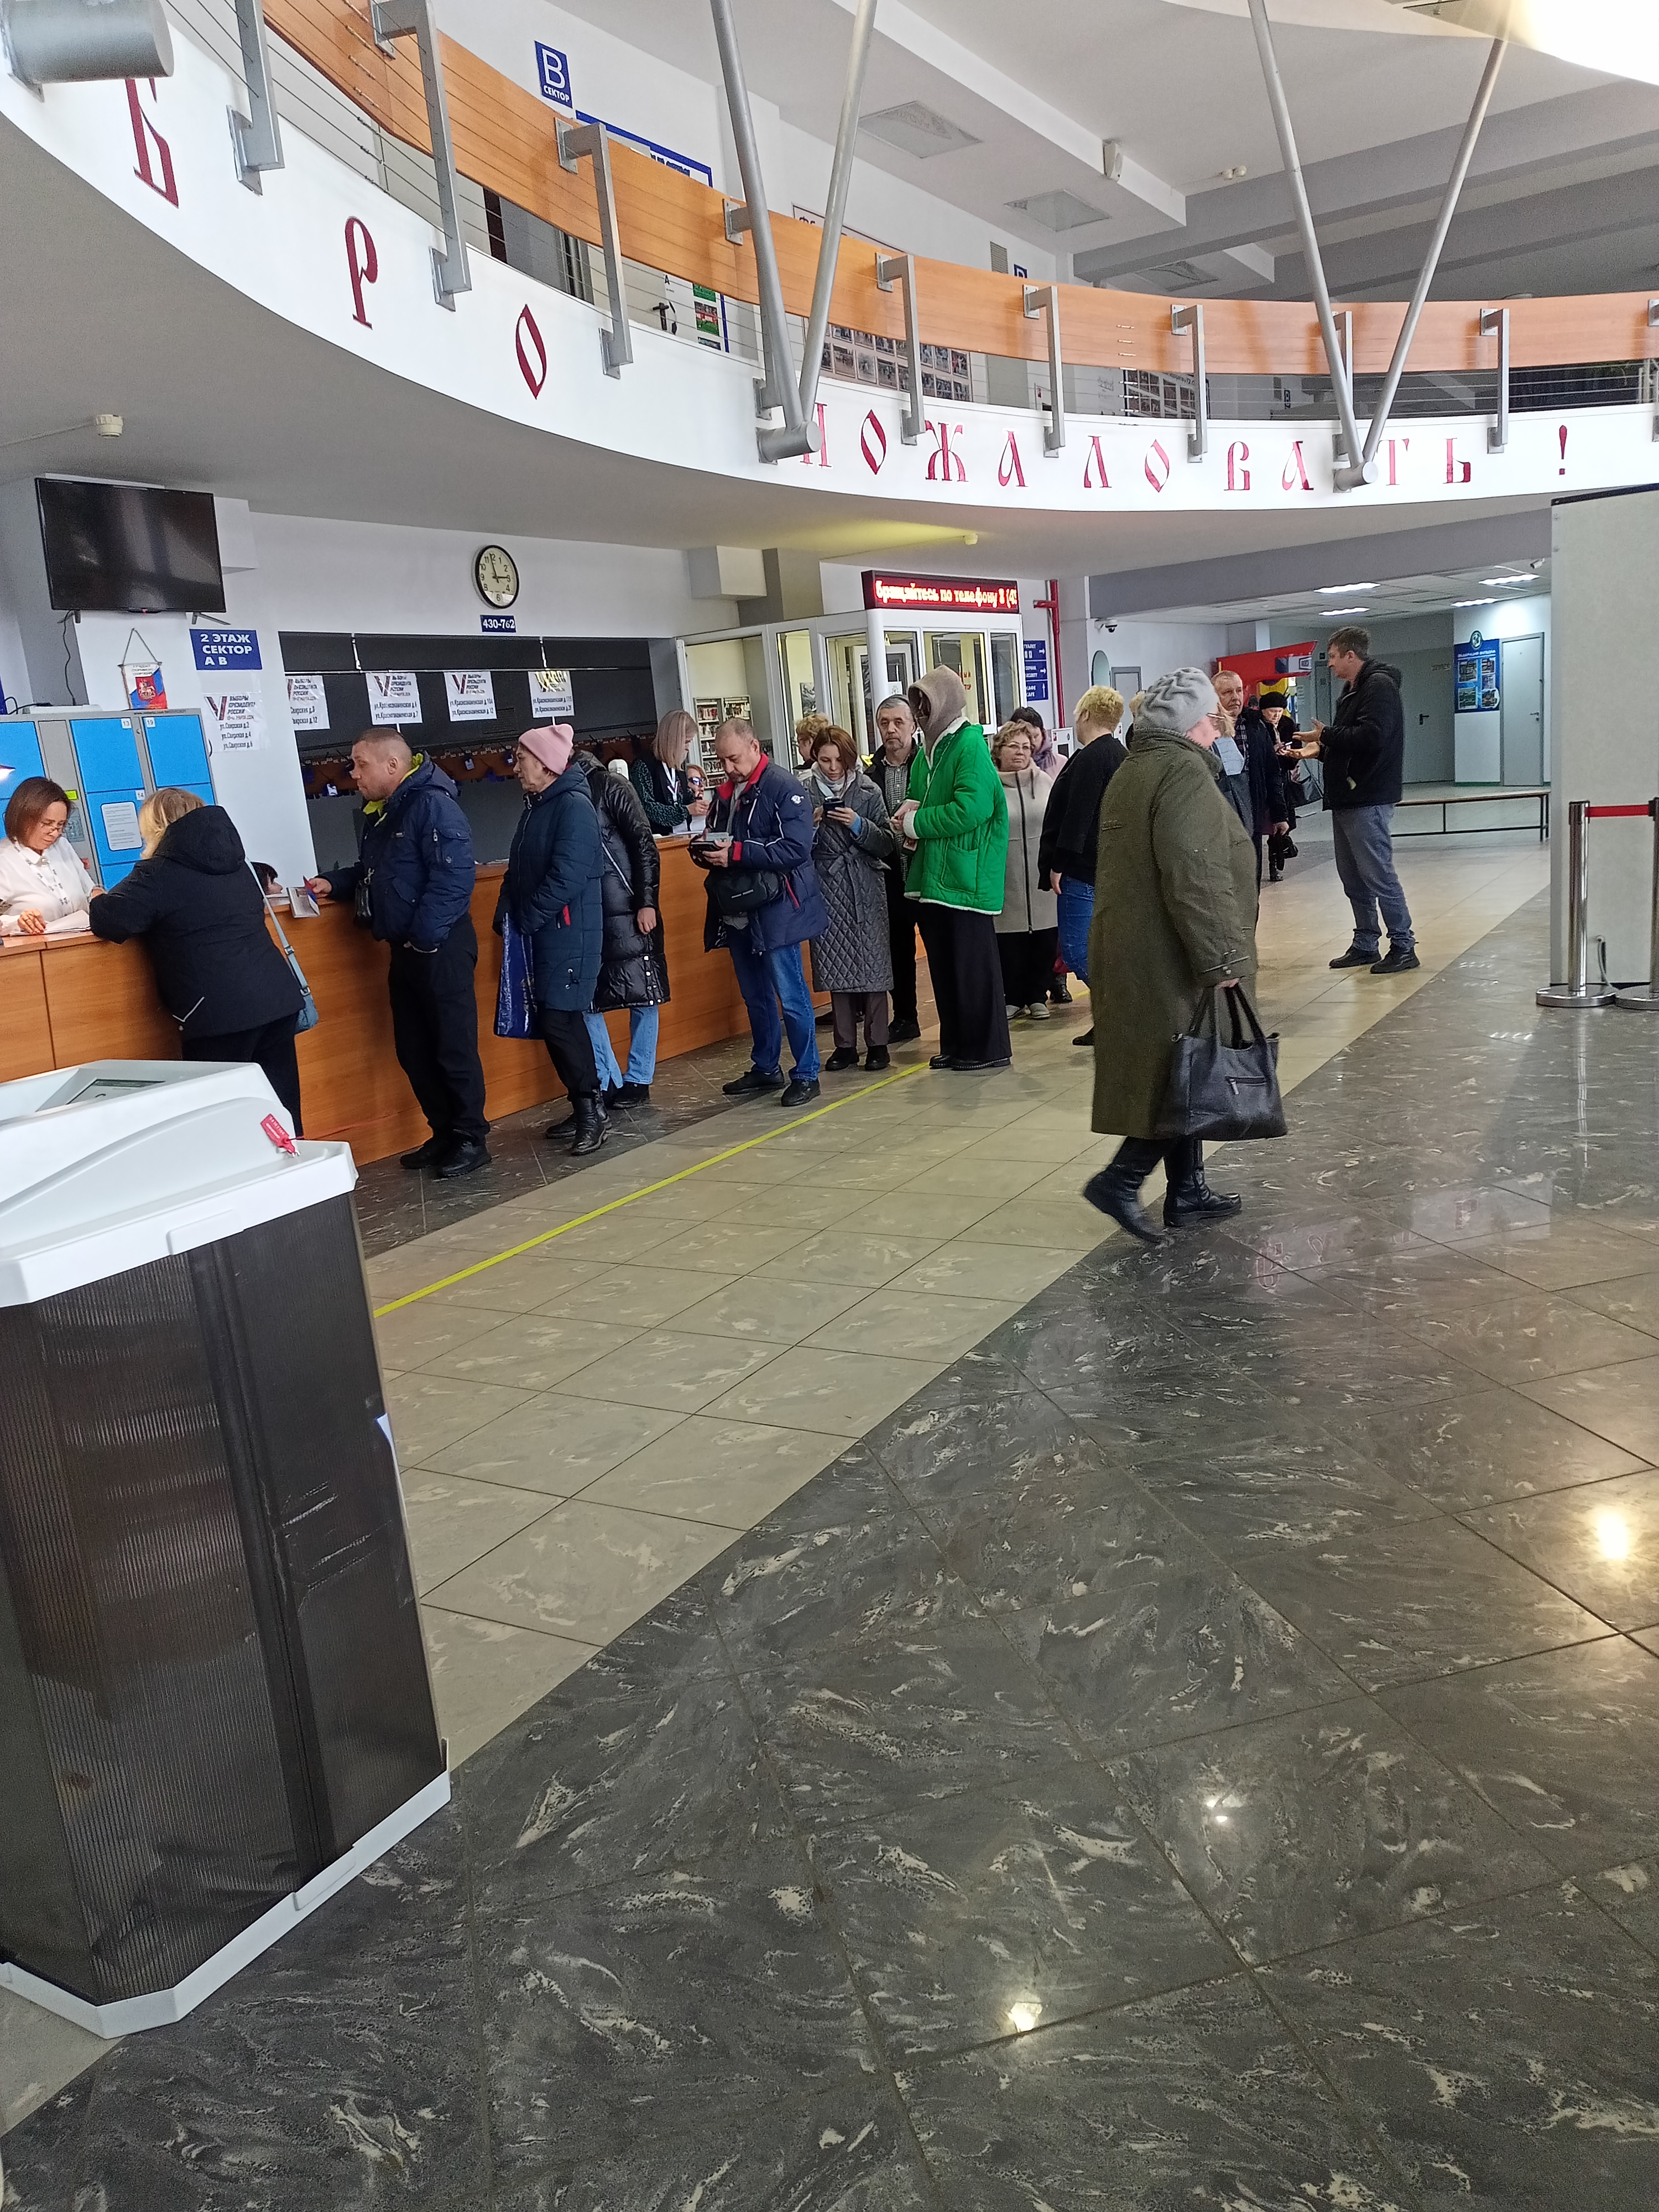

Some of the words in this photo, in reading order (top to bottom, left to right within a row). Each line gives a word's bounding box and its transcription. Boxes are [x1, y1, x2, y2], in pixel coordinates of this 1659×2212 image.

[542, 48, 565, 89] В
[544, 85, 570, 103] СЕКТОР
[940, 588, 952, 602] по
[954, 587, 998, 608] телефону
[200, 634, 209, 642] 2
[212, 634, 251, 643] ЭТАЖ
[202, 645, 252, 654] СЕКТОР
